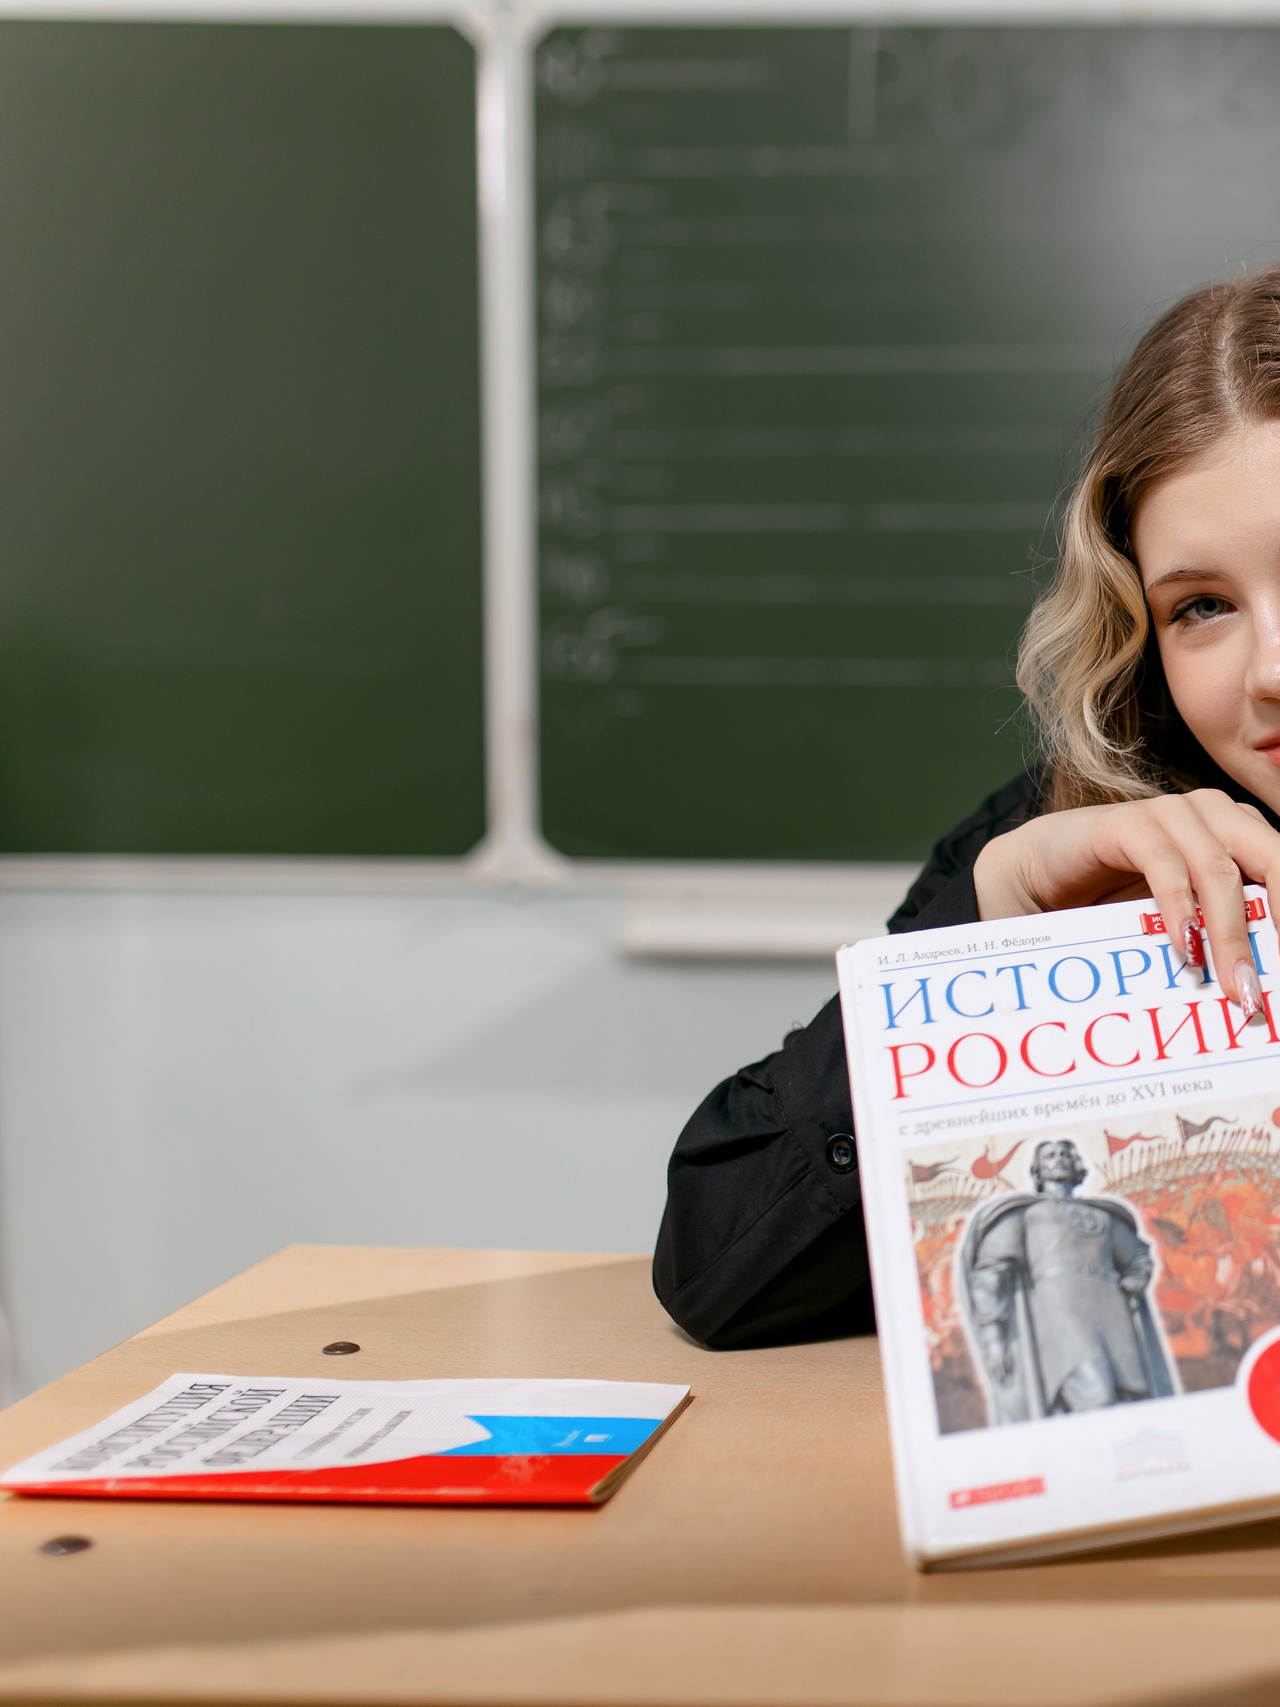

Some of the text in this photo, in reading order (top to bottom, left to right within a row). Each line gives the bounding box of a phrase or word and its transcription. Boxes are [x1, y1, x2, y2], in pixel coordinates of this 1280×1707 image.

[877, 934, 1052, 966] И. Л. Андреев, И. Н. Фёдоров
[878, 930, 1270, 1030] ИСТОРИ
[897, 1077, 1214, 1138] с древнейших времён до XVI века
[122, 1388, 287, 1469] РОССИЙСКОЙ
[200, 1394, 341, 1467] ФЕДЕРАЦИИ
